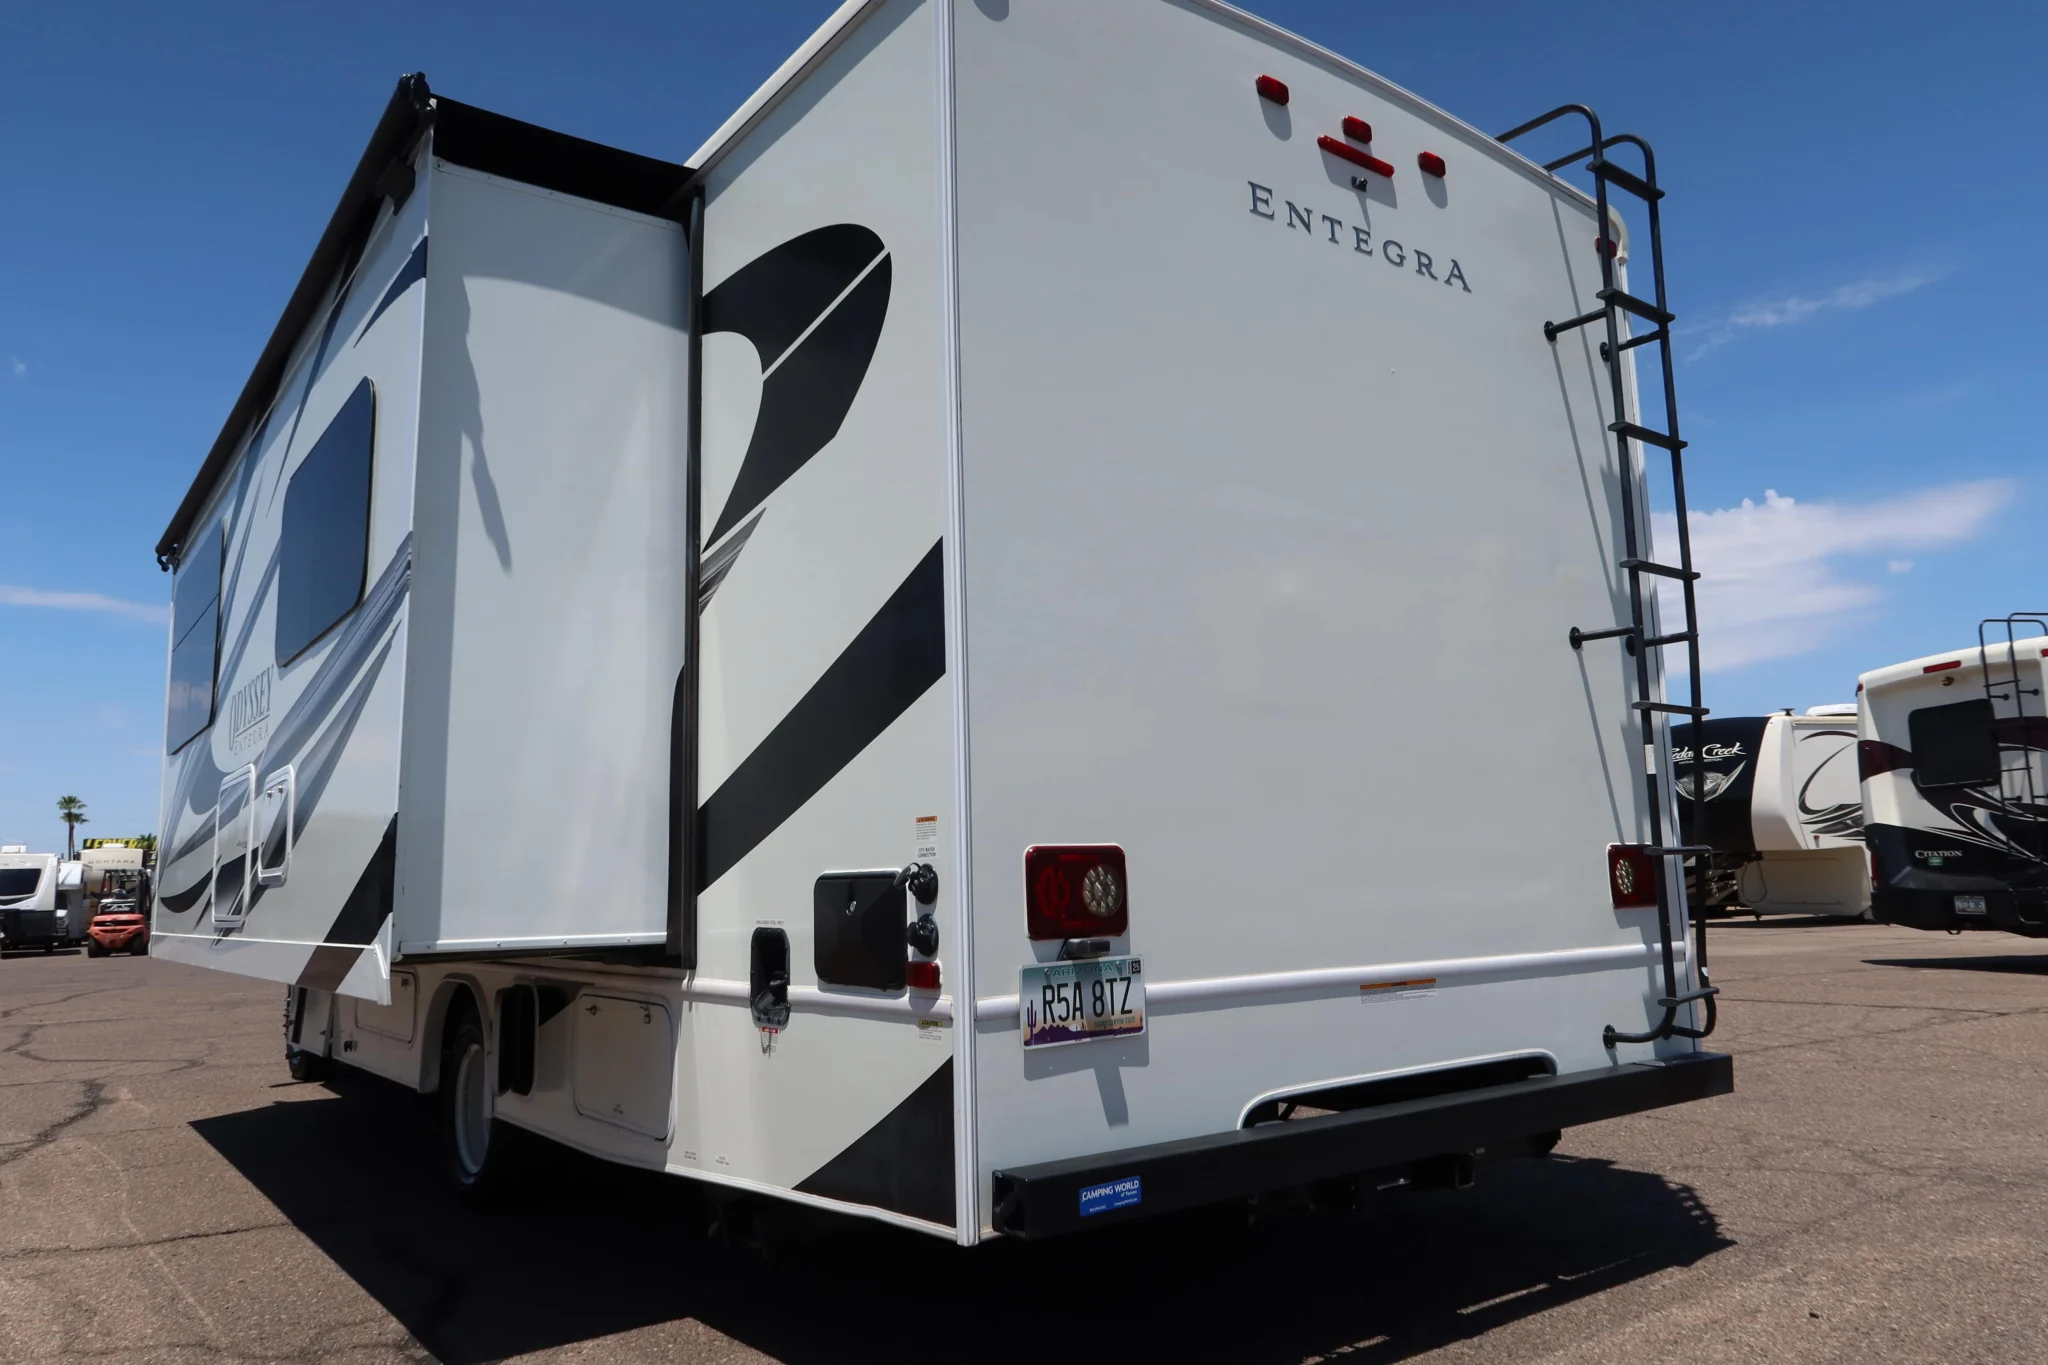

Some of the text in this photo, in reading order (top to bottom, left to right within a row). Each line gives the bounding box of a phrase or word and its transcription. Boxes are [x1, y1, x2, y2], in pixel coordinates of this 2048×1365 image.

[1247, 180, 1472, 294] ENTEGRA
[229, 664, 275, 752] ODYSSEY
[234, 721, 269, 756] ENTEGRA
[1702, 742, 1747, 759] Creek
[1052, 964, 1113, 977] ARIZONA
[1133, 962, 1140, 972] 25
[1042, 976, 1133, 1025] R5A 8TZ
[1082, 1180, 1139, 1202] CAMPING WORLD
